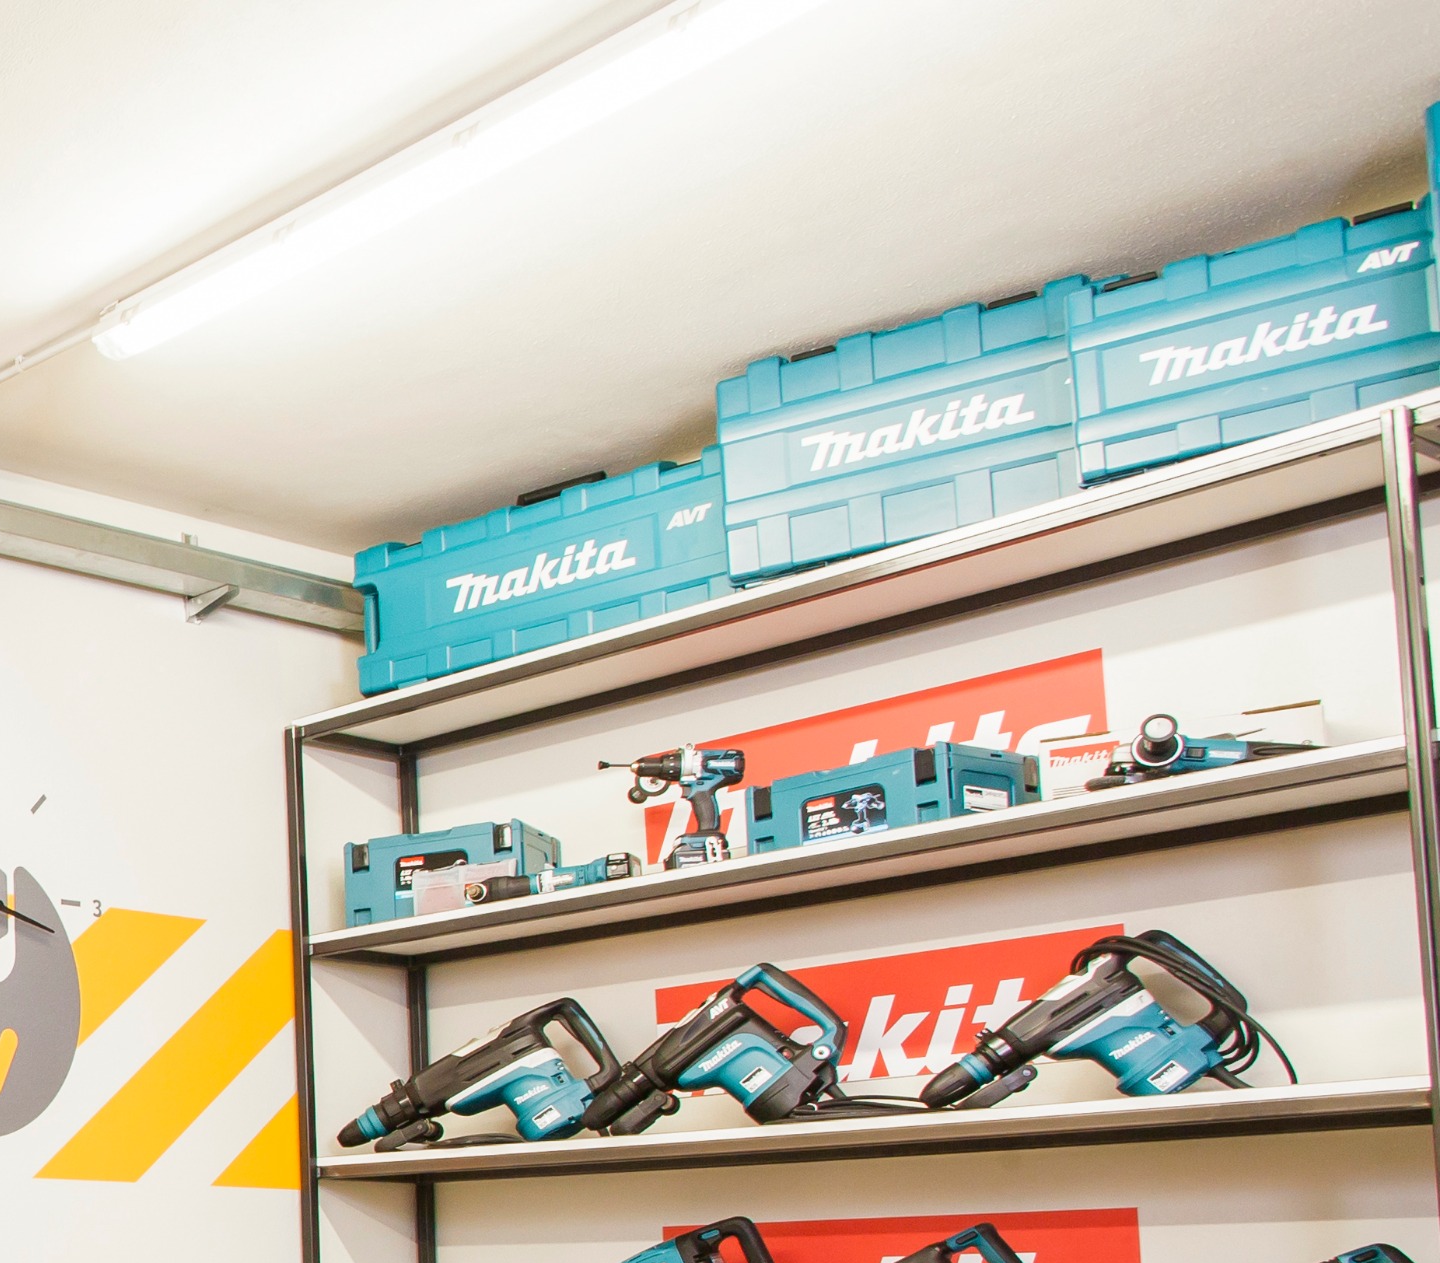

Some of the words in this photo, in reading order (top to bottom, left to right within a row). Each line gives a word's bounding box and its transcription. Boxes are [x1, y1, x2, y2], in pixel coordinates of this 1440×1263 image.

[1356, 241, 1420, 273] AVT
[1138, 303, 1389, 387] makita
[801, 390, 1036, 473] makita
[665, 502, 712, 531] AVT
[445, 532, 636, 614] makita
[92, 899, 102, 918] 3
[709, 998, 729, 1021] AVT
